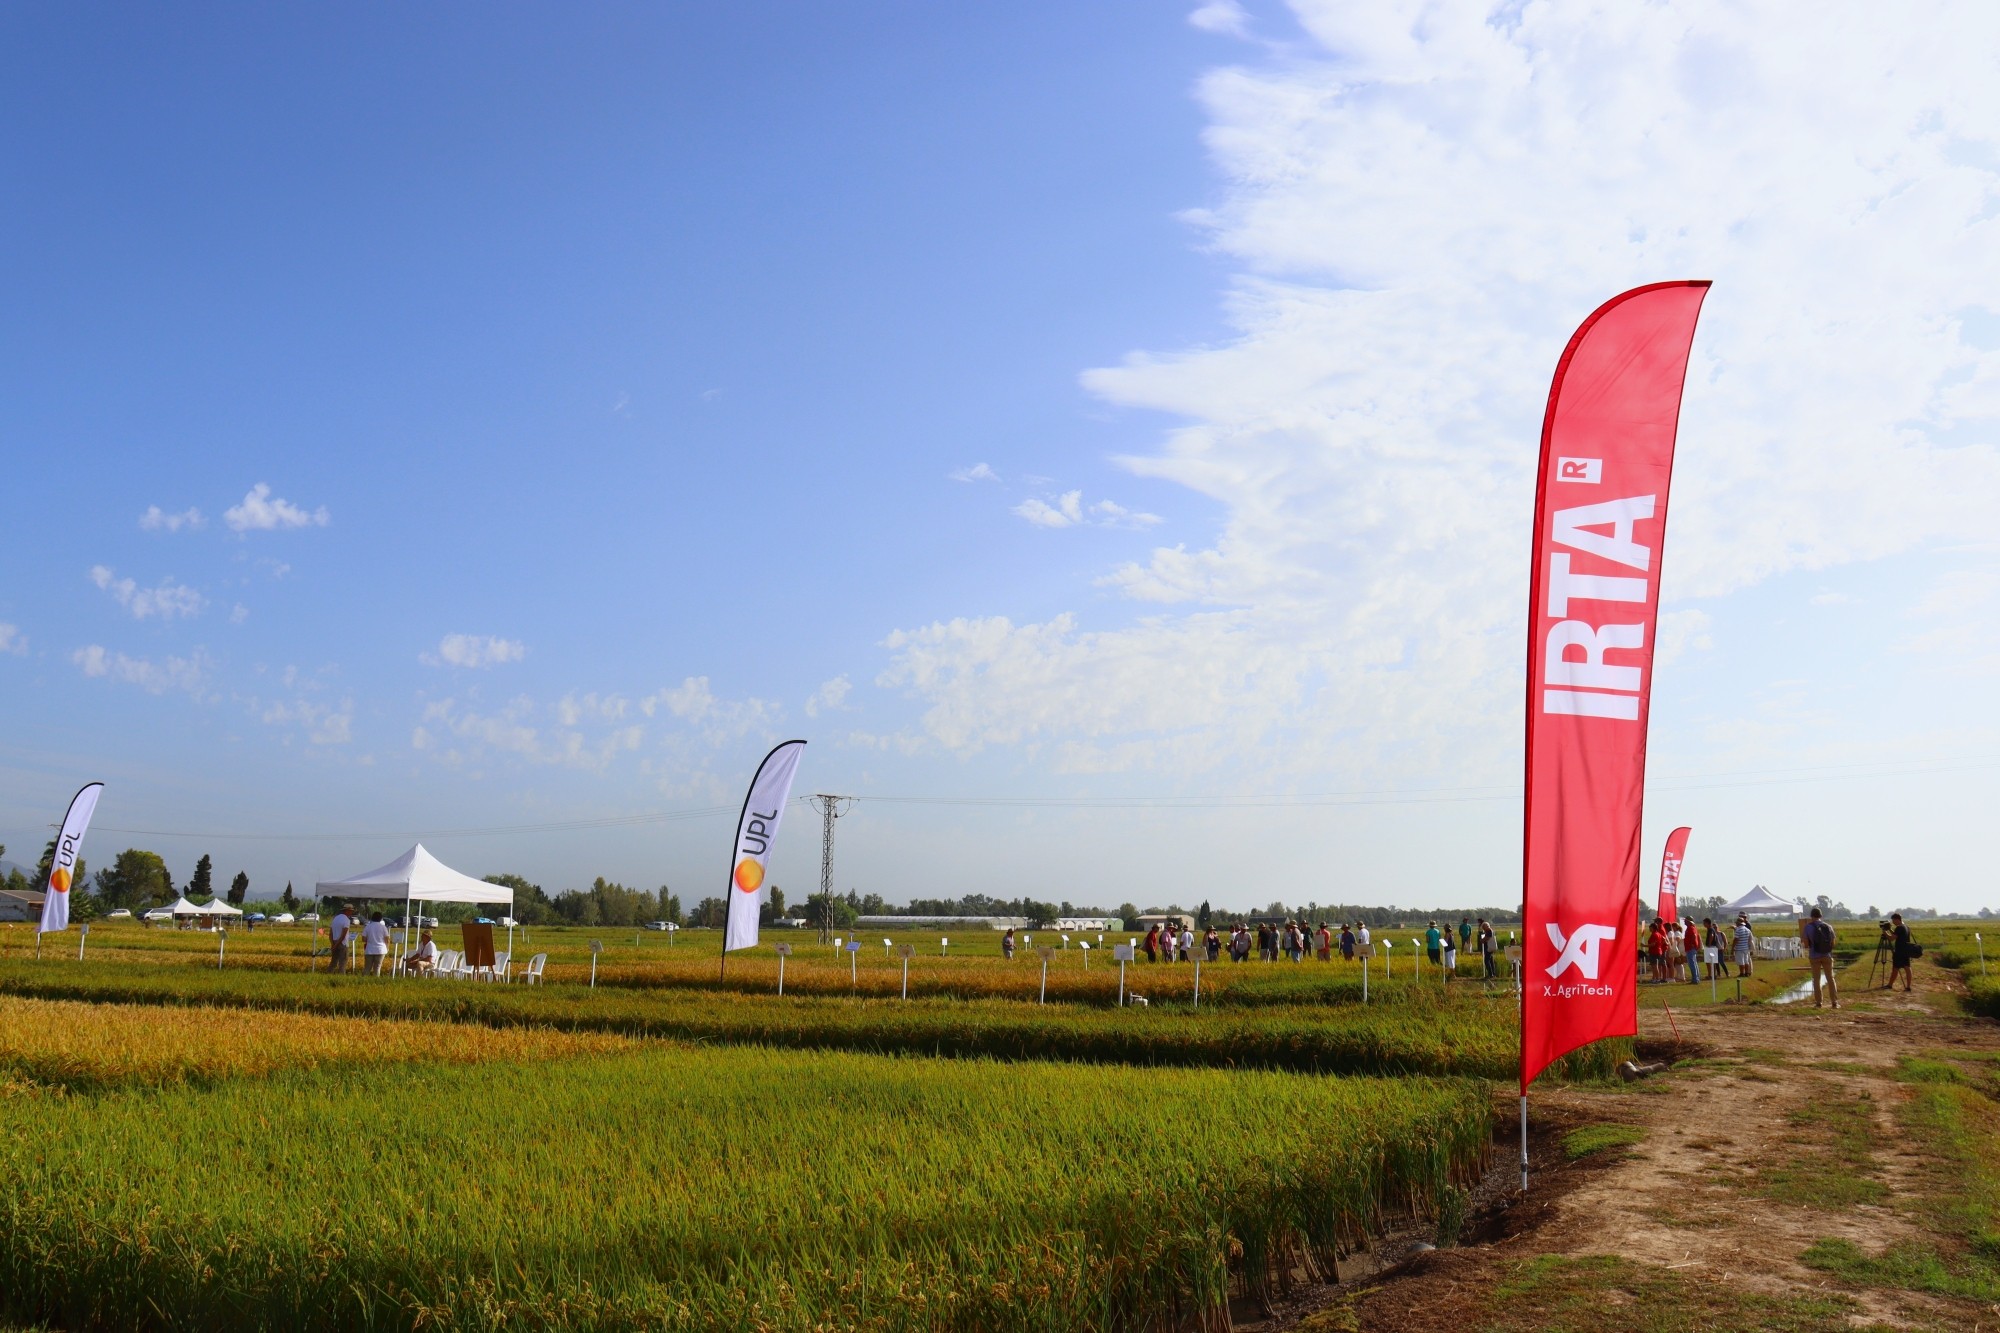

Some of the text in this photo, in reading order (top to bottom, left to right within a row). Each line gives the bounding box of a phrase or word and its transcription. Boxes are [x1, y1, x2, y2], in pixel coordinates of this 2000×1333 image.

[1543, 460, 1656, 721] IRTA R
[59, 832, 81, 867] UPL
[742, 809, 778, 855] UPL
[1661, 859, 1682, 894] IRTA
[1543, 984, 1613, 998] X_AgriTech
